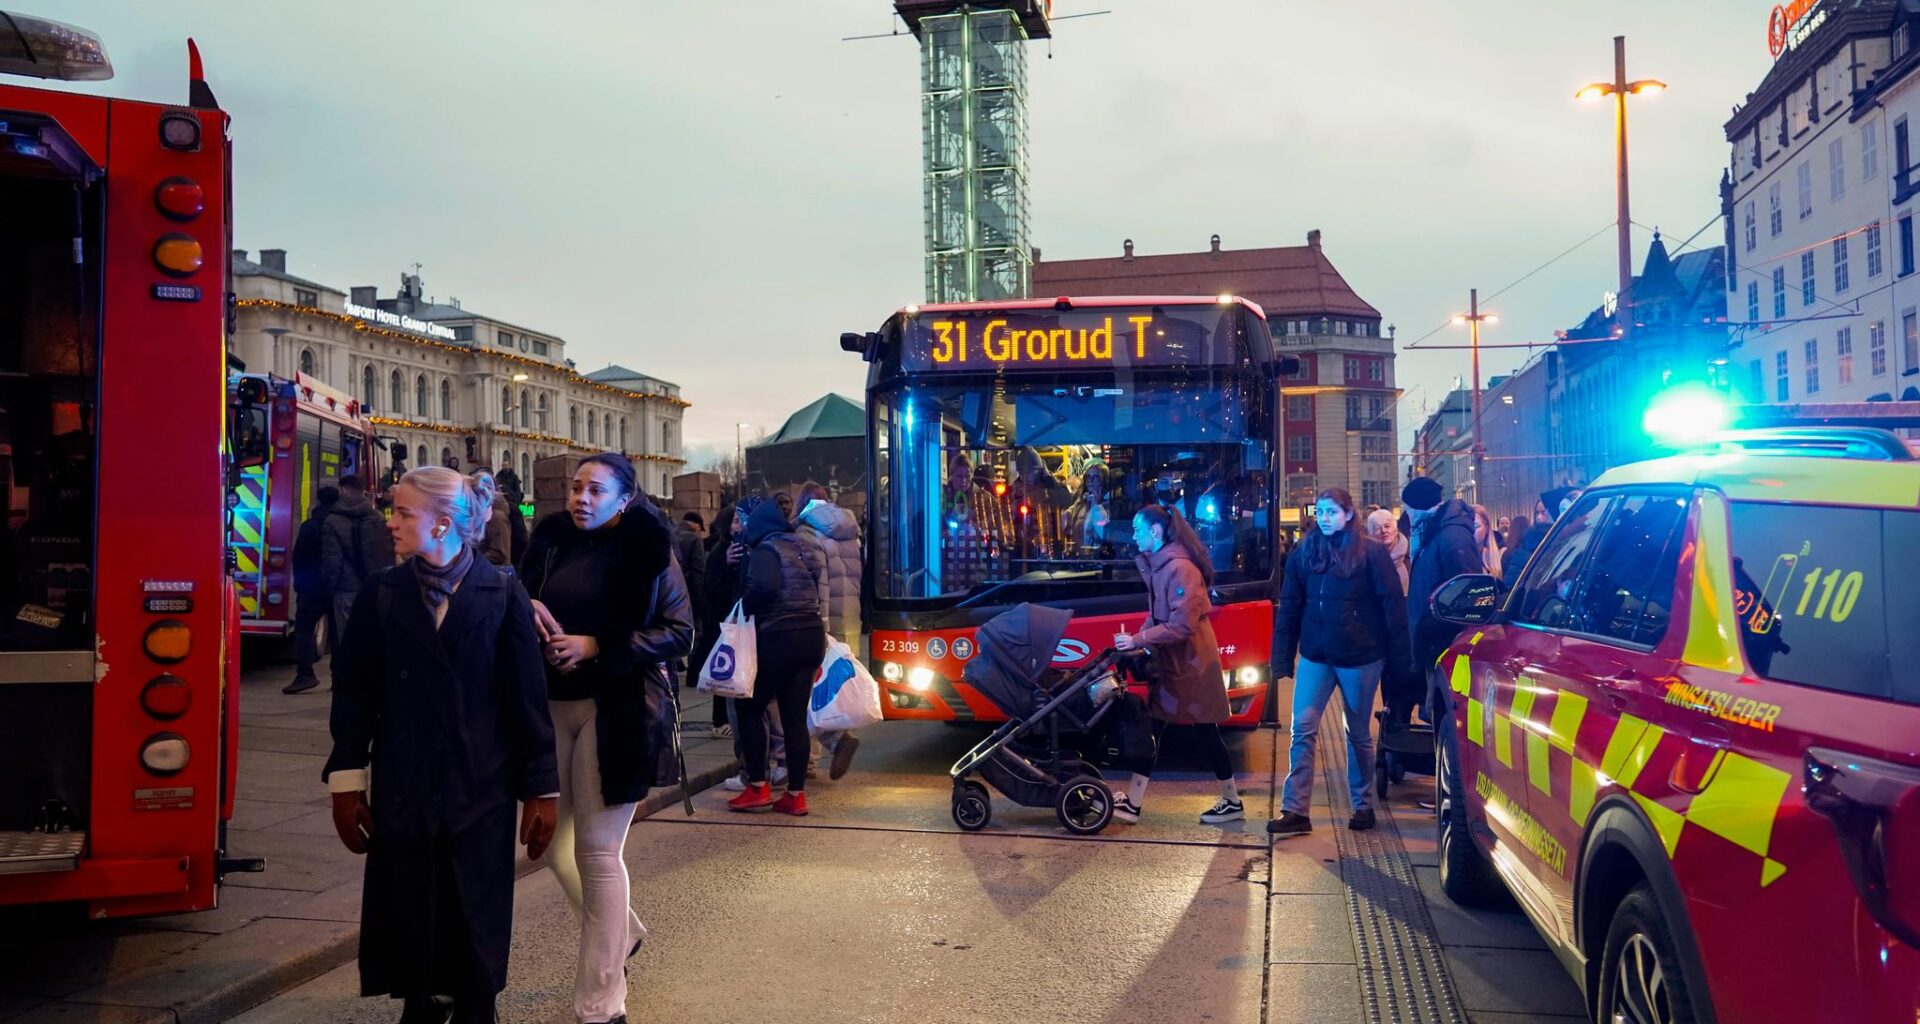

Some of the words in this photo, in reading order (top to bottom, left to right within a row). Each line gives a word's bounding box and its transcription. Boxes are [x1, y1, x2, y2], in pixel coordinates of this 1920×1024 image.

[344, 302, 376, 320] OMFORT
[377, 309, 400, 326] HOTEL
[401, 315, 427, 333] GRAND
[427, 322, 456, 340] CENTRAL
[932, 321, 967, 363] 31
[983, 317, 1113, 362] Grorud
[1128, 316, 1153, 359] T
[1795, 567, 1864, 623] 110
[882, 640, 896, 652] 23
[898, 642, 919, 654] 309
[1664, 682, 1782, 733] INNSATSLEDER
